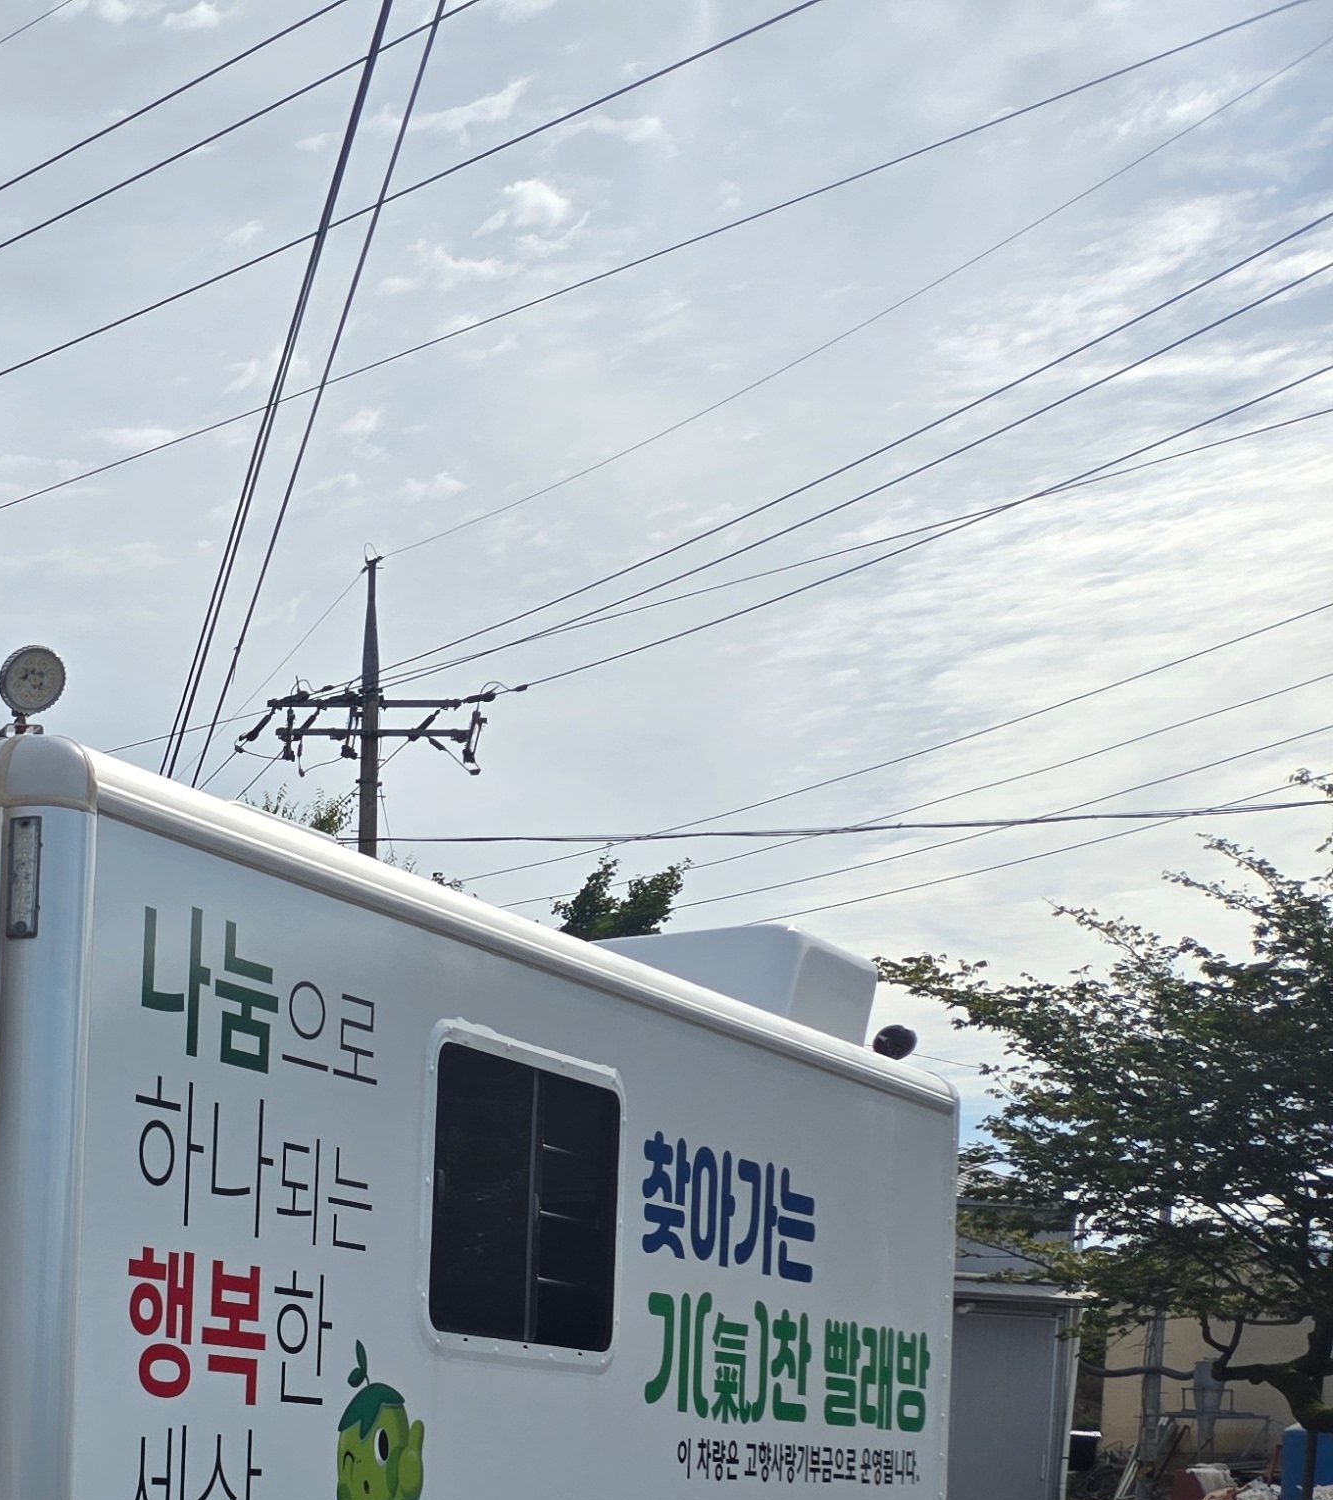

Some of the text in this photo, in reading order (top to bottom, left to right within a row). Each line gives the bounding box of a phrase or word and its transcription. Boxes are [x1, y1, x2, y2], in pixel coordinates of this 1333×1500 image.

[140, 905, 378, 1086] 나눔으로
[134, 1075, 374, 1252] 하나되는
[641, 1130, 816, 1283] 찾아가는
[128, 1245, 332, 1406] 행복한
[644, 1291, 930, 1433] 기(氣)찬 빨래방
[677, 1438, 920, 1486] 이 차량은 고향사랑기부금으로 운영됩니다.
